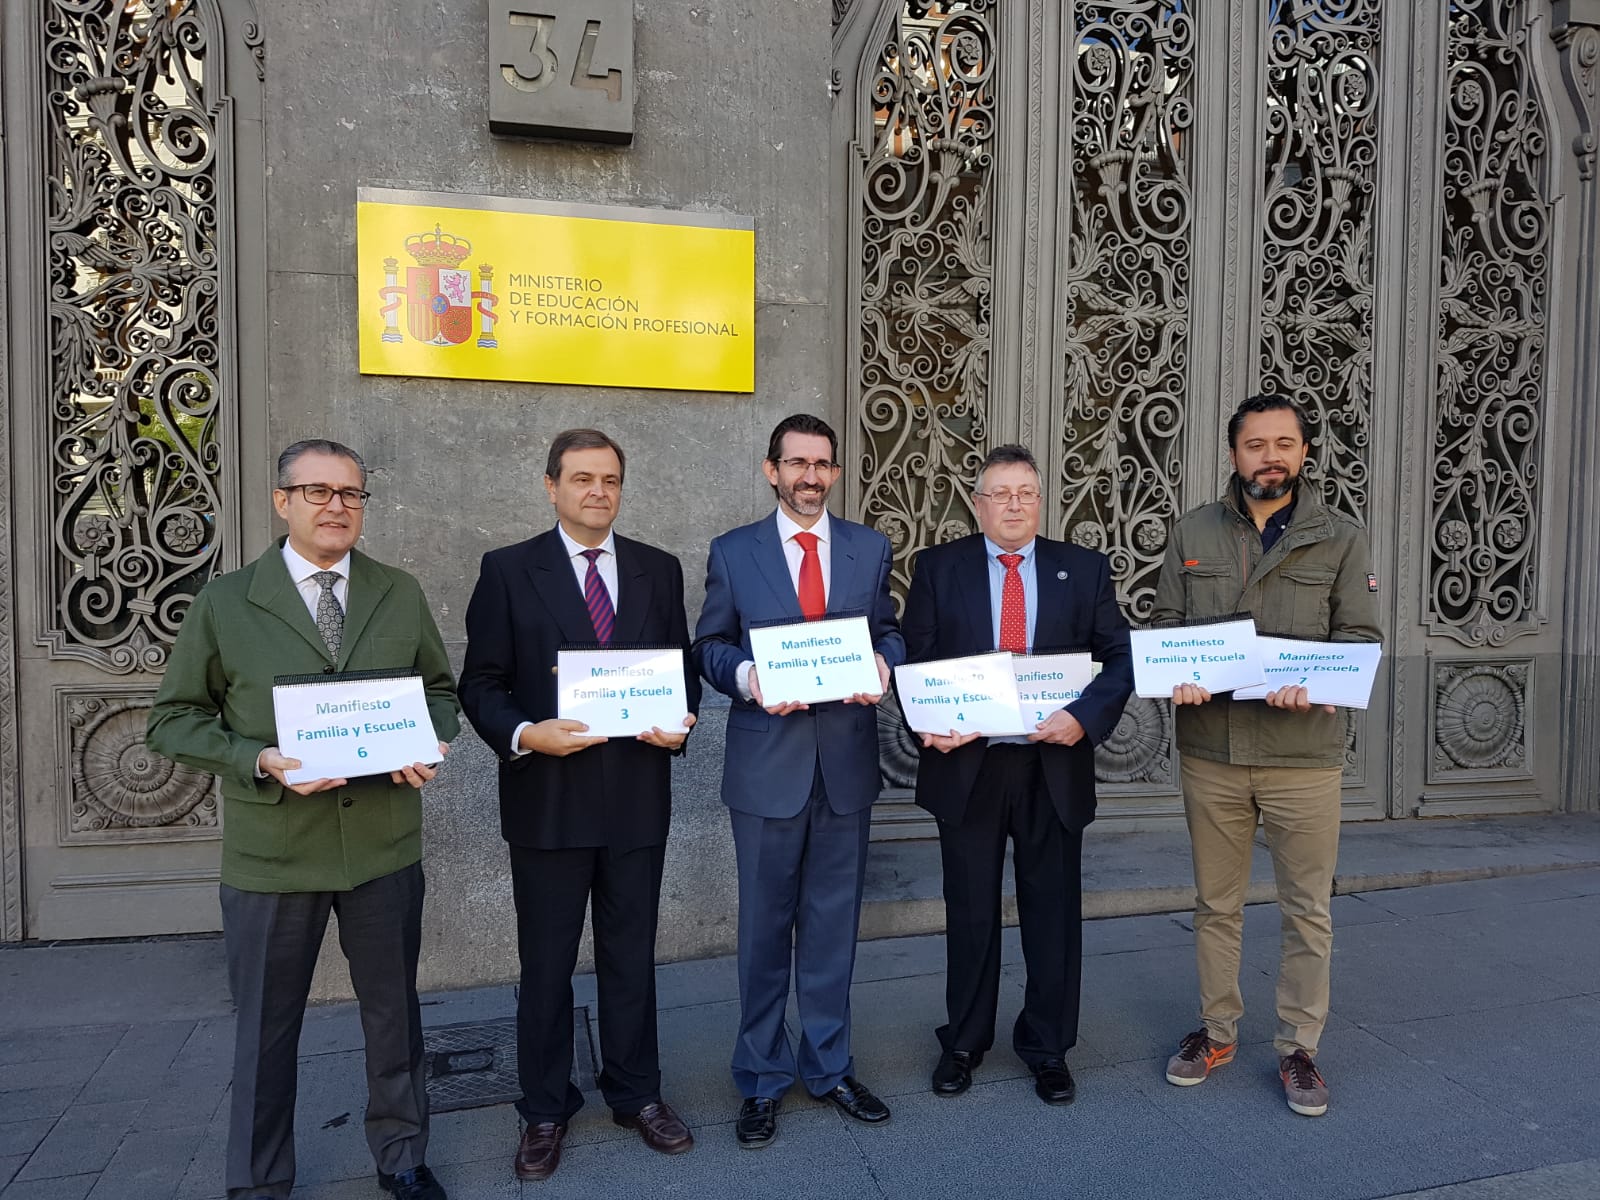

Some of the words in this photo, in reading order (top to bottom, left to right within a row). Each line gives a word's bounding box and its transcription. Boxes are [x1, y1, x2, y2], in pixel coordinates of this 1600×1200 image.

[499, 10, 622, 102] 34
[508, 273, 603, 293] MINISTERIO
[509, 292, 533, 308] DE
[537, 293, 639, 312] EDUCACIÓN
[510, 310, 520, 324] Y
[526, 311, 628, 330] FORMACIÓN
[634, 319, 739, 337] PROFESIONAL
[781, 636, 842, 650] Manifiesto
[1161, 638, 1225, 649] Manifiesto
[767, 657, 808, 670] Familia
[810, 658, 819, 669] y
[820, 653, 862, 666] Escuela
[1145, 654, 1188, 664] Familia
[1190, 656, 1198, 665] y
[1200, 652, 1246, 663] Escuela
[1278, 652, 1345, 661] Manifiesto
[590, 665, 654, 678] Manifiesto
[1313, 664, 1360, 673] Escuela
[815, 675, 823, 686] 1
[1015, 671, 1064, 682] anifiesto
[1193, 672, 1200, 681] 5
[1299, 676, 1307, 684] 7
[573, 687, 617, 699] Familia
[619, 689, 627, 700] y
[629, 686, 673, 698] Escuela
[1041, 689, 1080, 700] Escuela
[911, 695, 951, 705] Familia
[953, 696, 960, 705] y
[316, 699, 391, 715] Manifiesto
[620, 708, 629, 720] 3
[956, 712, 965, 722] 4
[1035, 711, 1044, 721] 2
[296, 725, 349, 741] Familia
[352, 727, 360, 737] y
[364, 718, 417, 734] Escuela
[357, 746, 368, 758] 6
